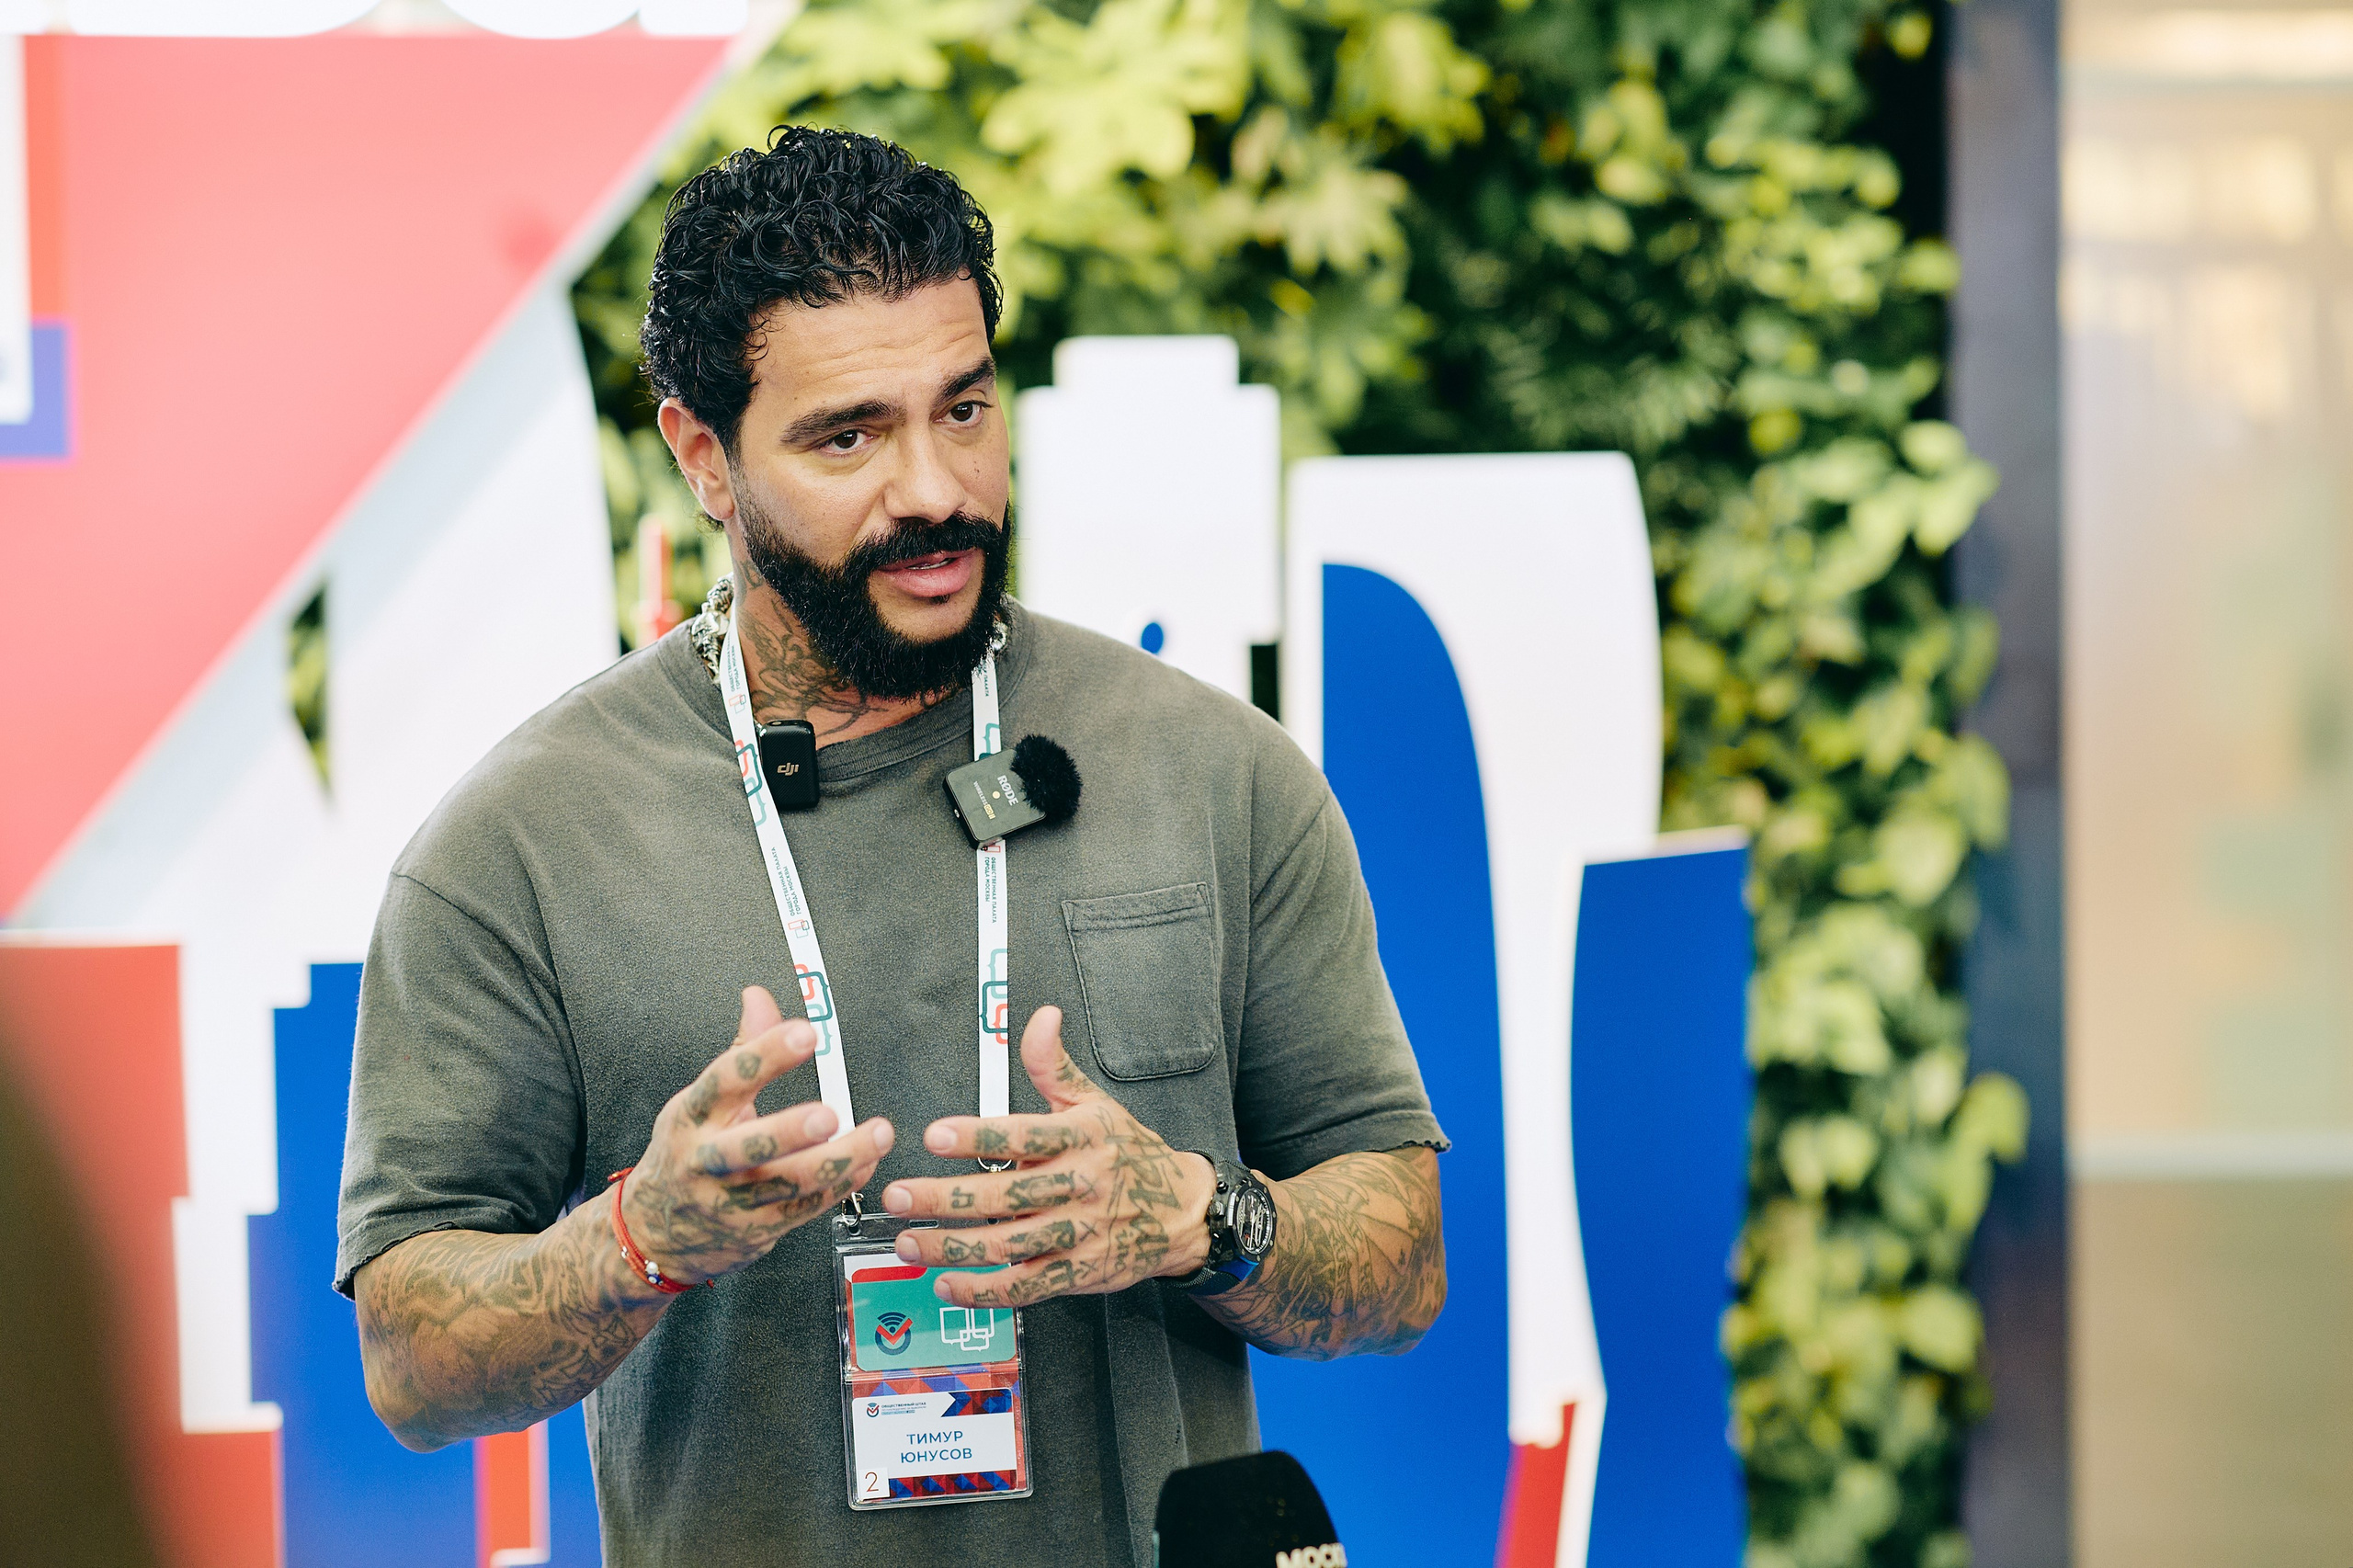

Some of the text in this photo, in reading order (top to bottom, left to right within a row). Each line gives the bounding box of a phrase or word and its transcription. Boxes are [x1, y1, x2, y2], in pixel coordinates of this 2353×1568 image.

[997, 775, 1019, 806] RØDE
[771, 846, 795, 916] ОБЩЕСТВЕННАЯ ПАЛАТА
[783, 866, 801, 915] ГОРОДА МОСКВЫ
[906, 1430, 963, 1445] ТИМУР
[901, 1448, 972, 1463] ЮНУСОВ
[865, 1471, 879, 1493] 2
